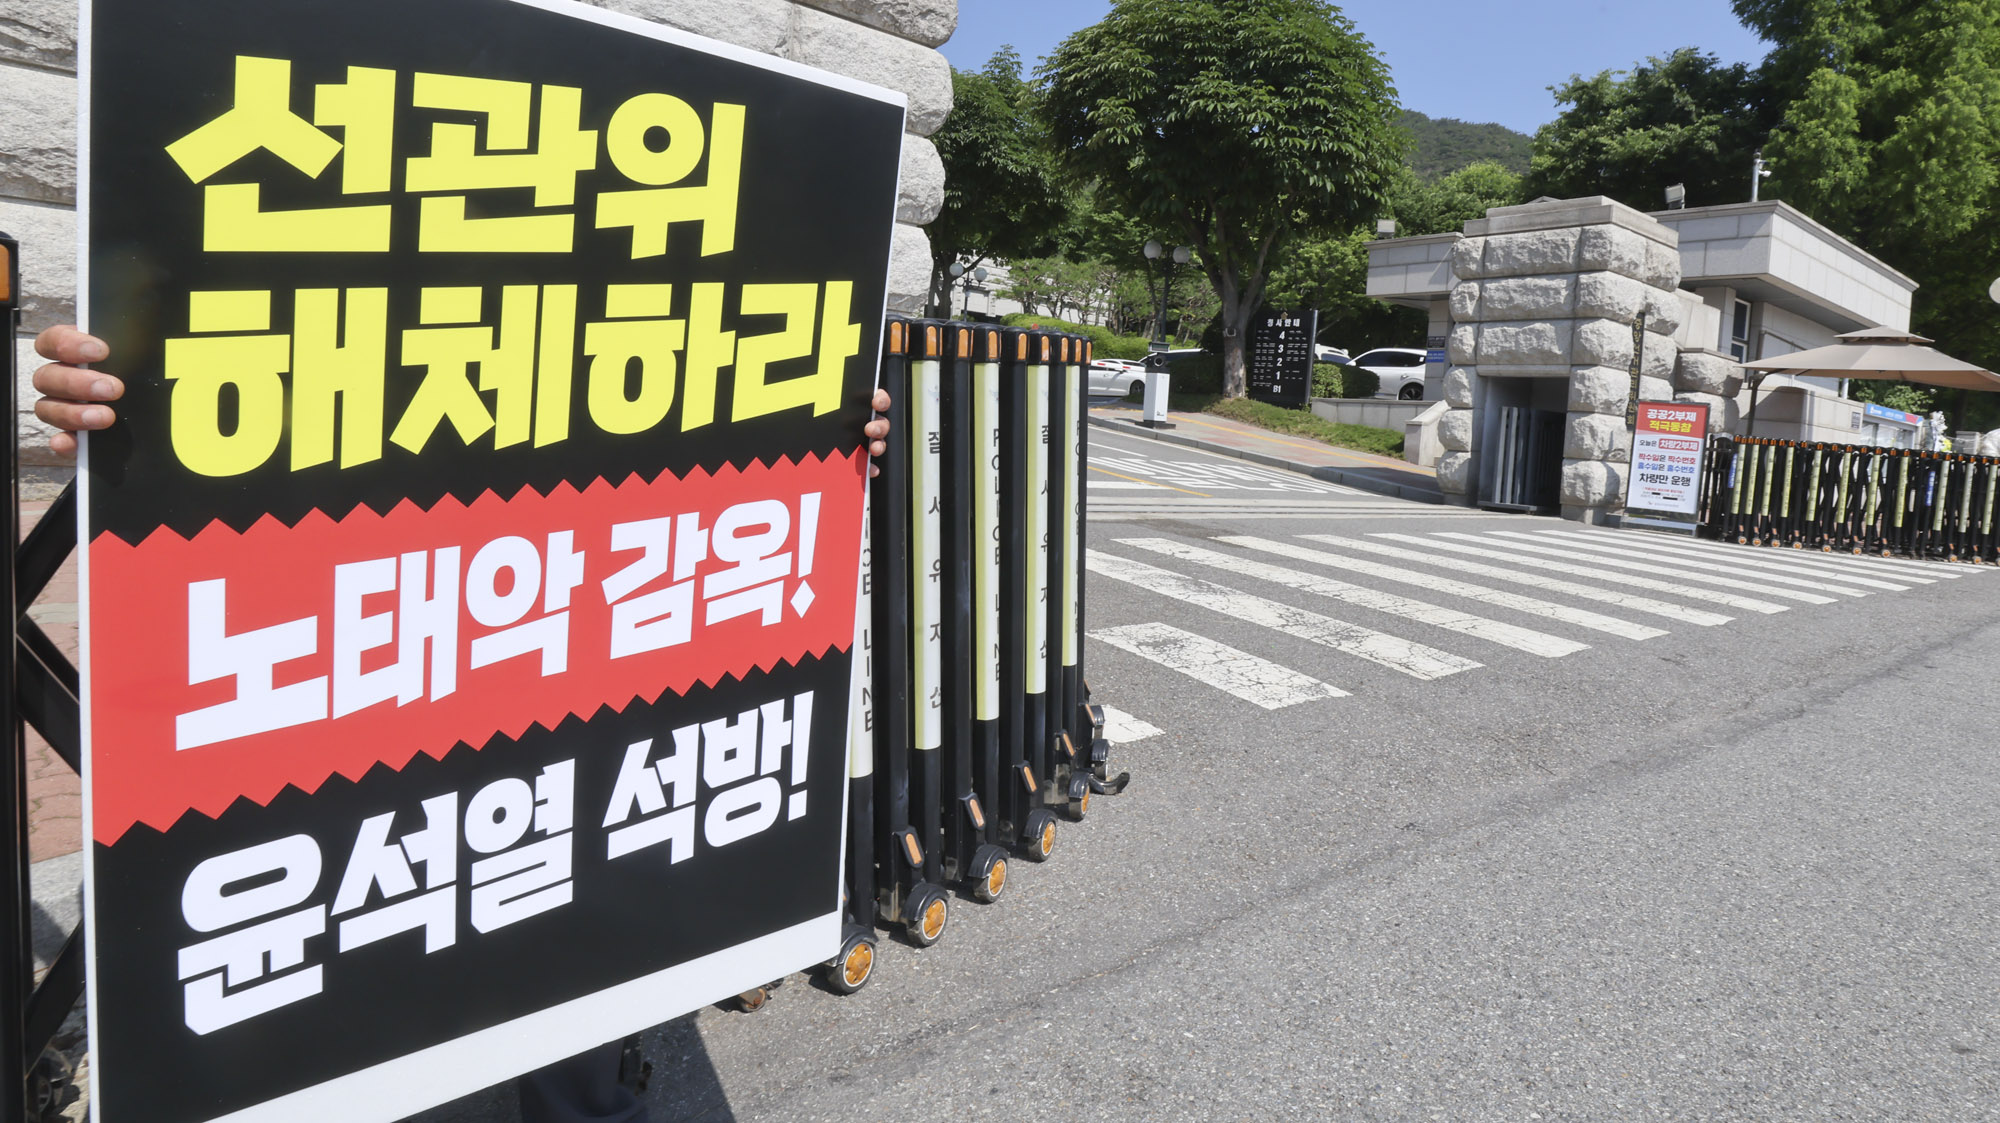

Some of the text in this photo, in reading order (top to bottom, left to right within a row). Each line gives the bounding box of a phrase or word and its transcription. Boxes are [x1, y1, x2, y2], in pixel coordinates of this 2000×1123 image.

[166, 56, 745, 259] 선관위
[1279, 331, 1286, 340] 4
[1277, 344, 1284, 354] 3
[1276, 357, 1283, 367] 2
[166, 281, 860, 476] 해체하라
[1276, 371, 1281, 380] 1
[1272, 385, 1282, 393] B1
[1647, 408, 1697, 422] 공공2부제
[1649, 420, 1692, 433] 적극동참
[1639, 439, 1698, 451] 오늘은 차량2부제
[1638, 473, 1691, 487] 차량만 운행
[176, 530, 585, 751] 노태악
[602, 492, 821, 659] 감옥!
[178, 691, 813, 1035] 윤석열 석방!
